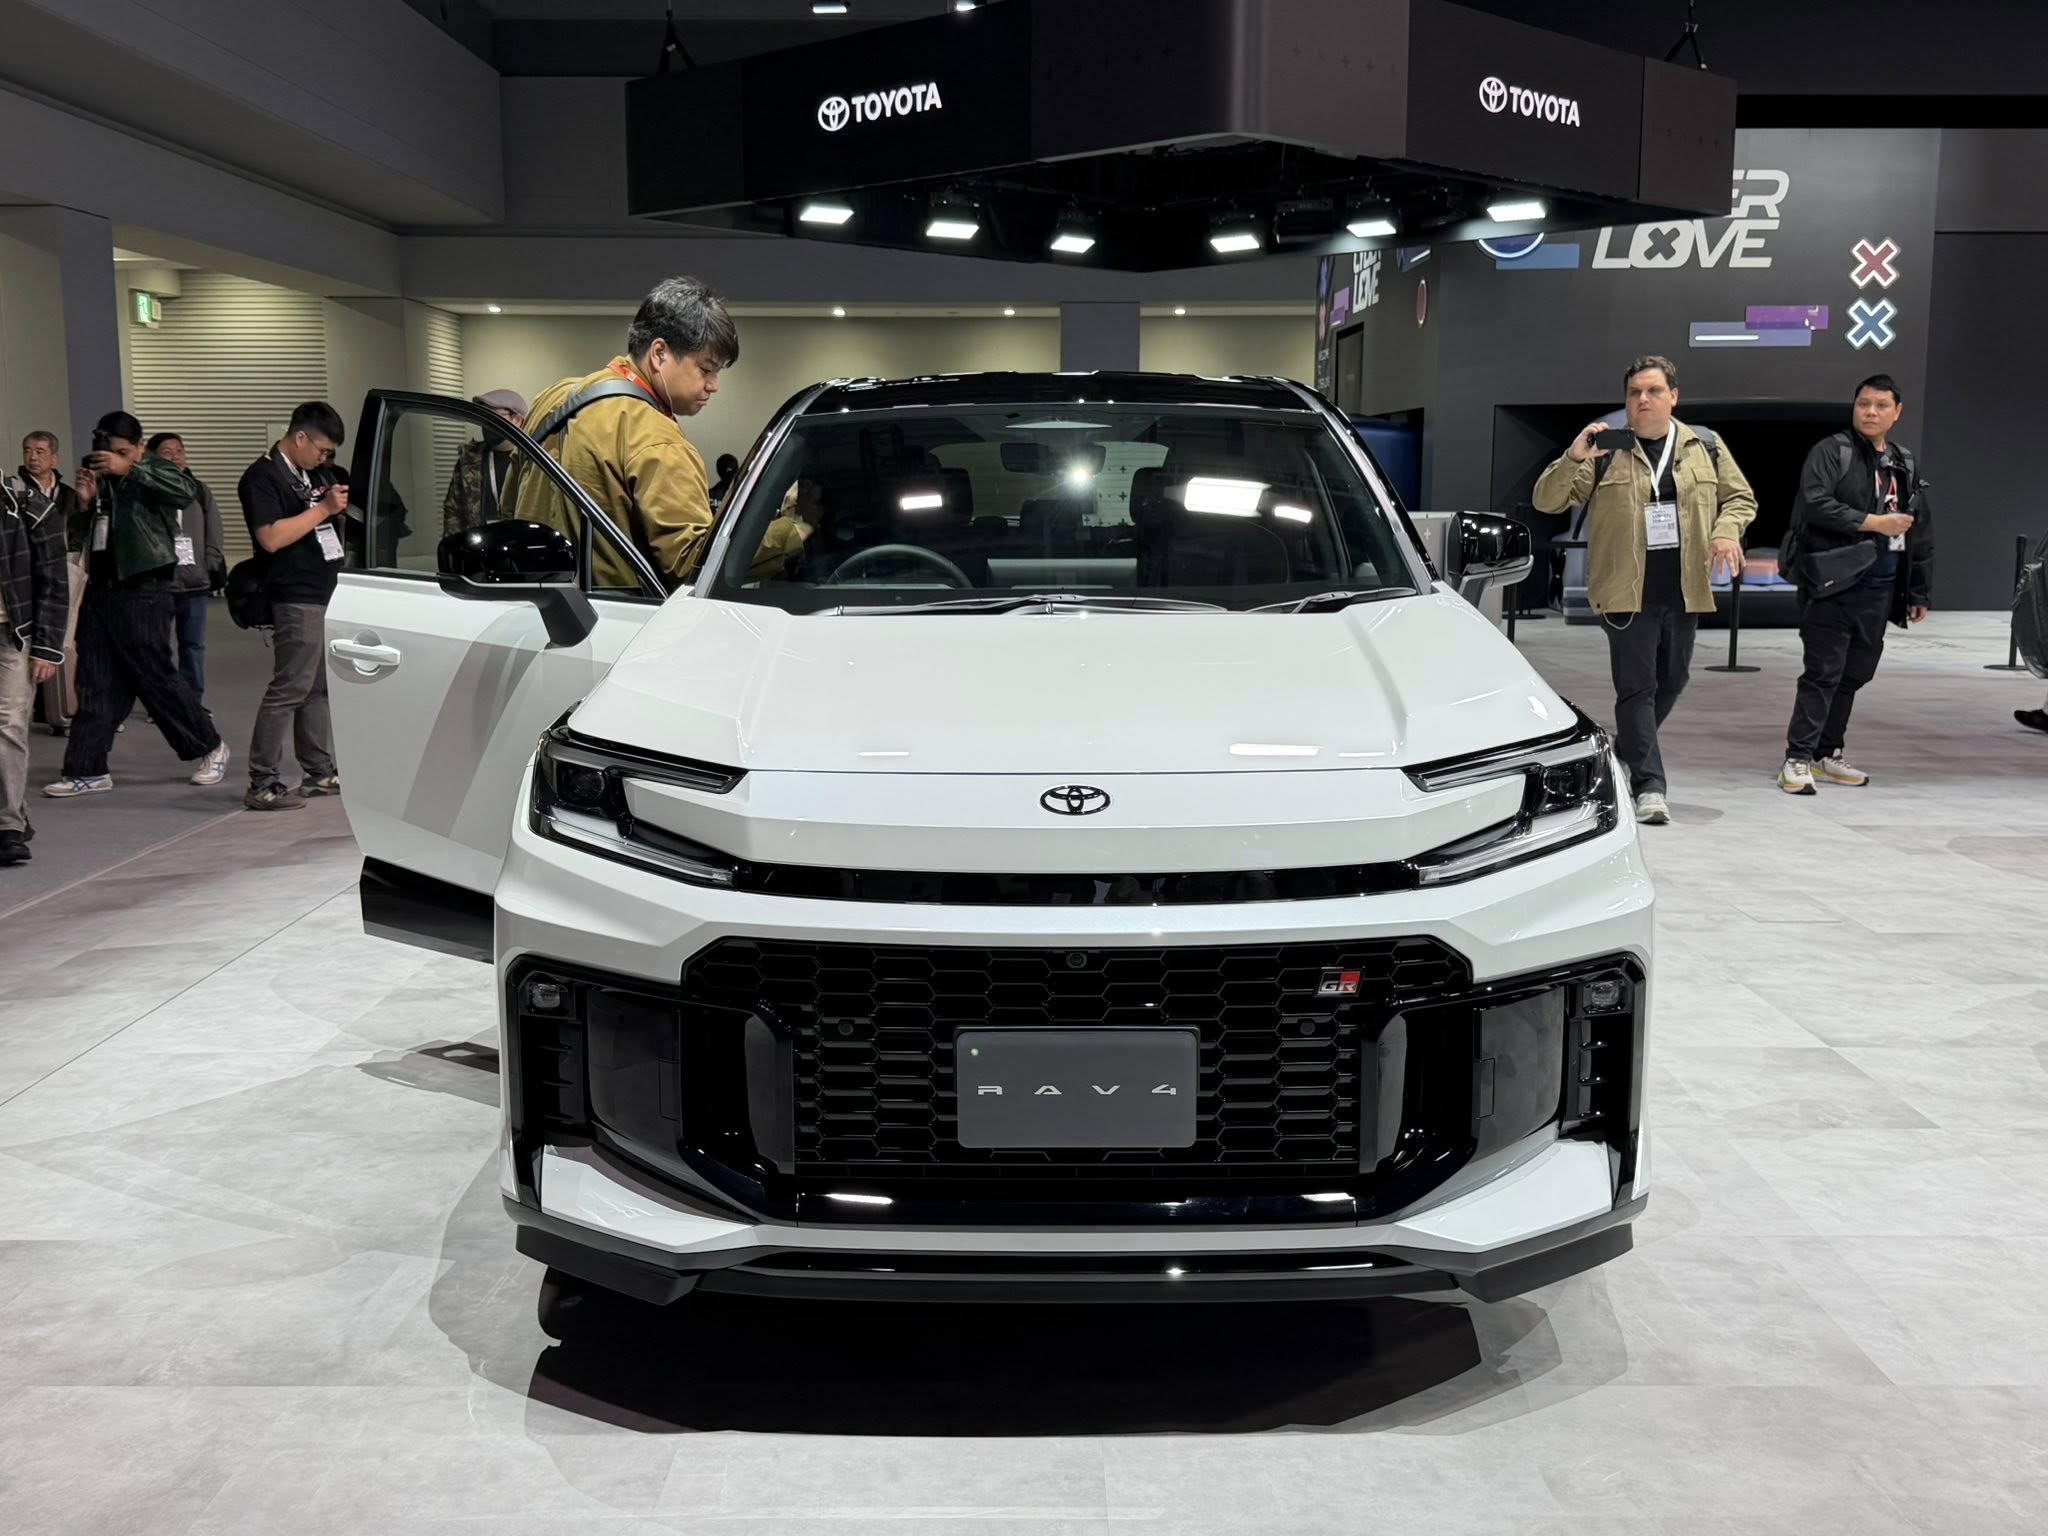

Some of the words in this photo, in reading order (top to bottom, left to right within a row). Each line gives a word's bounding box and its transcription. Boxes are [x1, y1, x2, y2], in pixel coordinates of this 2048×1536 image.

[851, 82, 942, 122] TOYOTA
[1509, 86, 1580, 127] TOYOTA
[1592, 219, 1780, 269] LOVE
